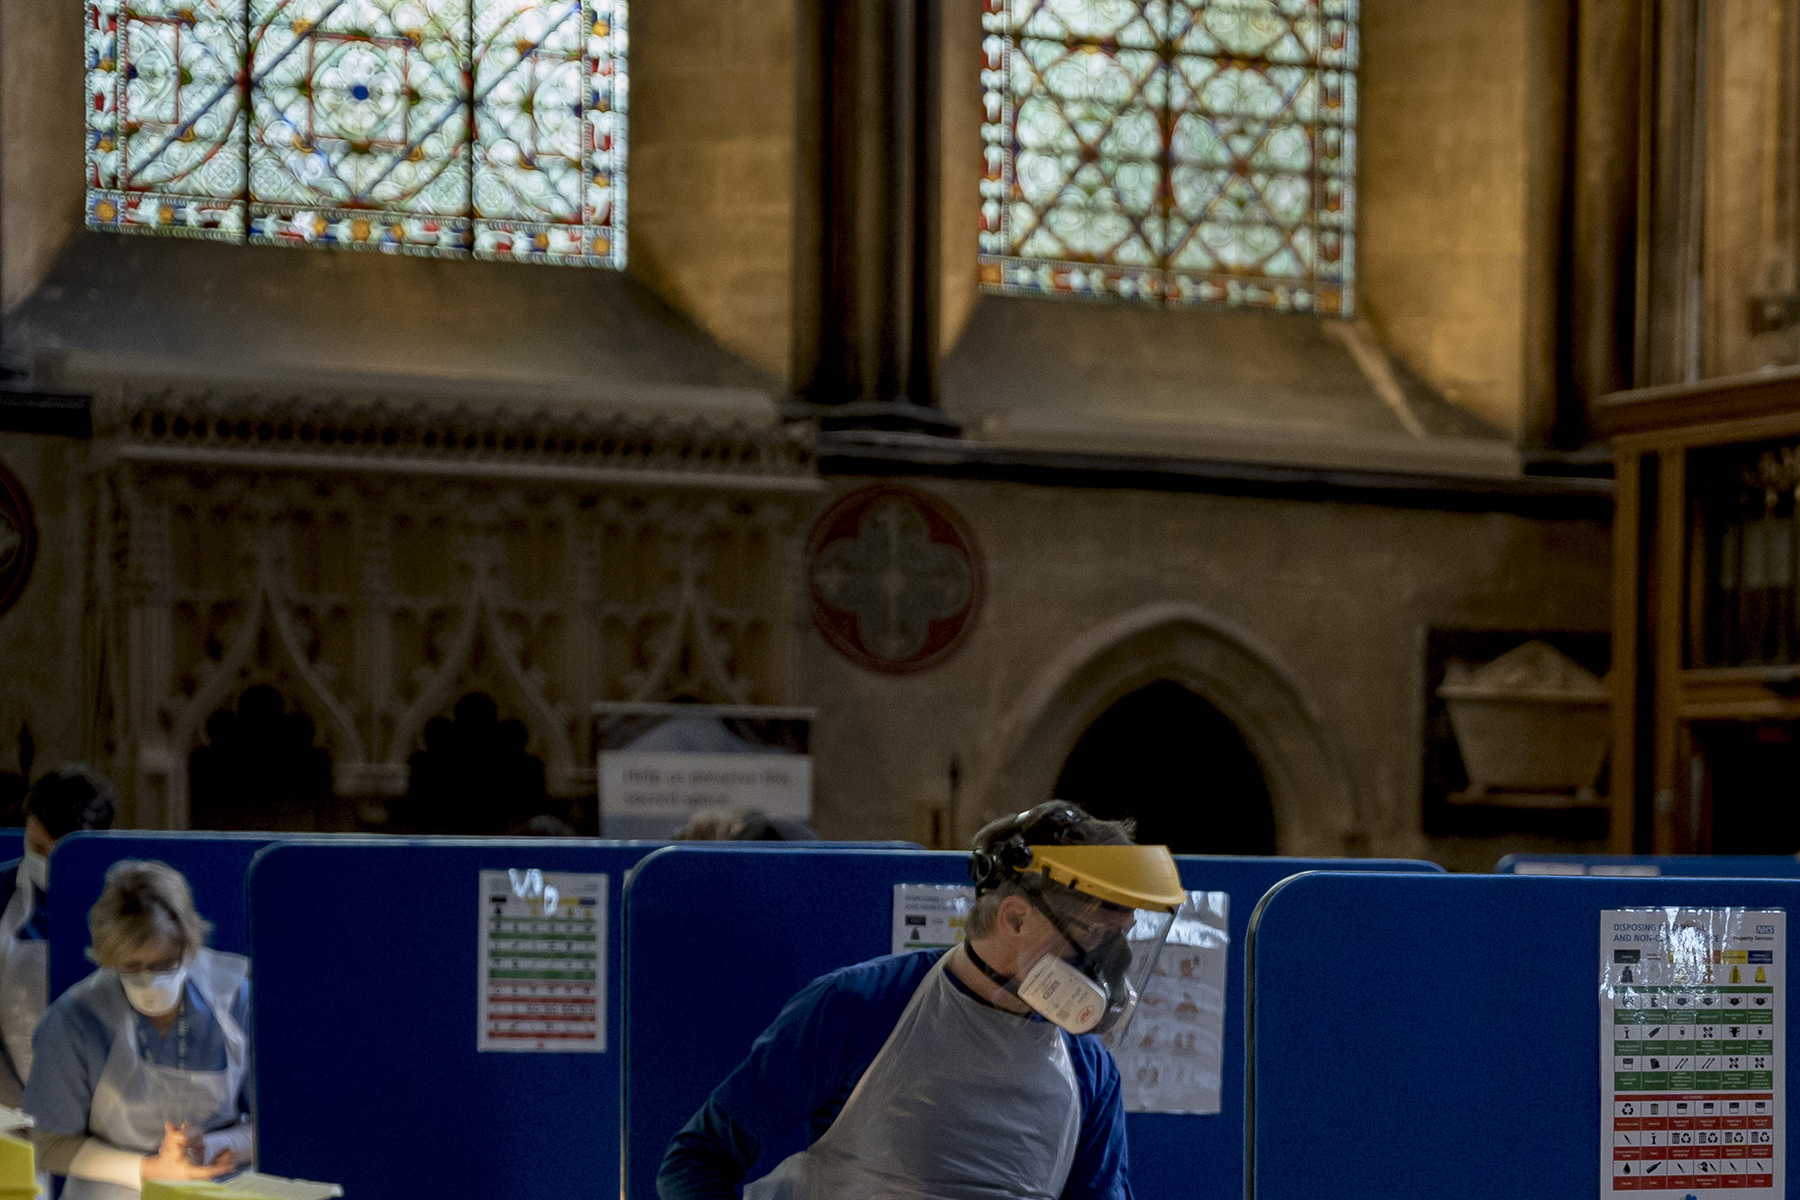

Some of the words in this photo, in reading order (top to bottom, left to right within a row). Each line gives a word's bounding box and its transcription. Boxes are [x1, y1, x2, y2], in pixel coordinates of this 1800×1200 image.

[1613, 923, 1656, 932] DISPOSING
[1756, 925, 1774, 934] NHS
[1613, 934, 1631, 942] AND
